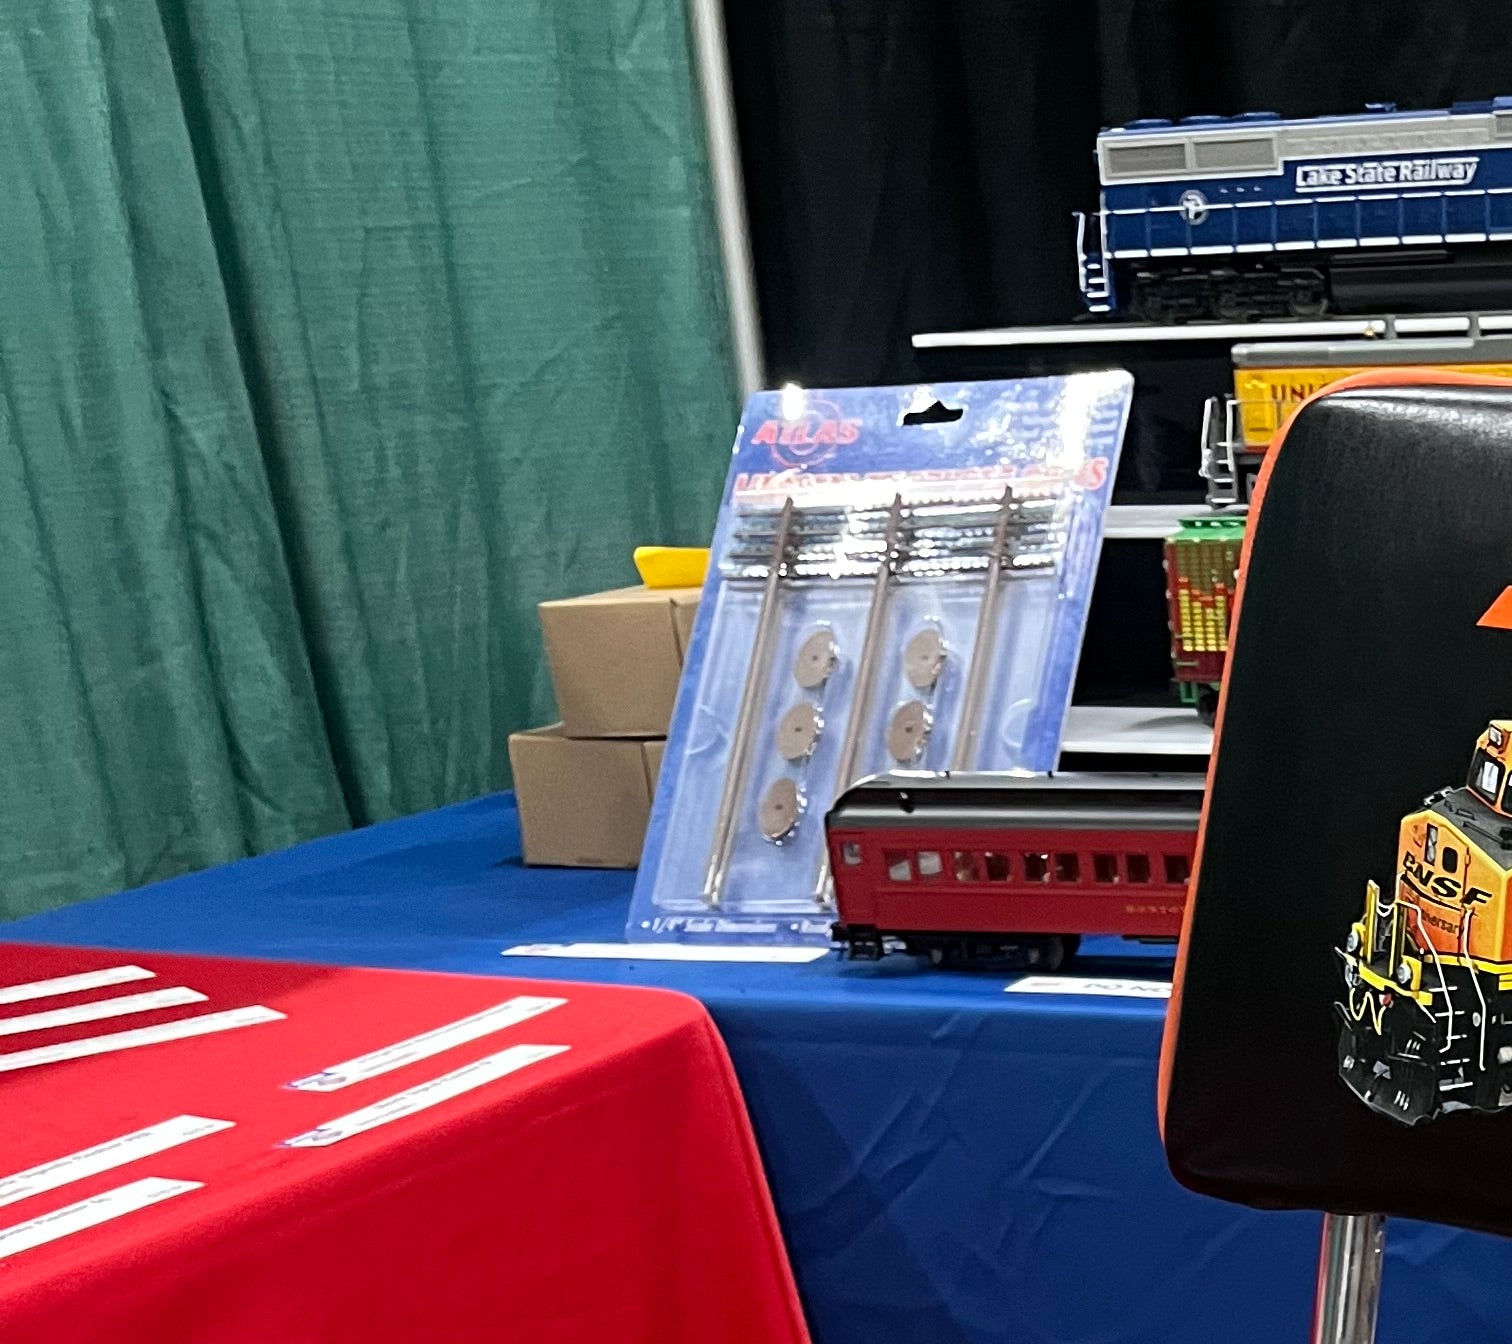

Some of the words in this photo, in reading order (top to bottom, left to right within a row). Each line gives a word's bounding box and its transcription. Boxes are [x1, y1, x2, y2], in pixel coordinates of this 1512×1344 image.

[1296, 165, 1343, 187] Lake
[1344, 163, 1397, 184] State
[1399, 159, 1478, 182] Railway
